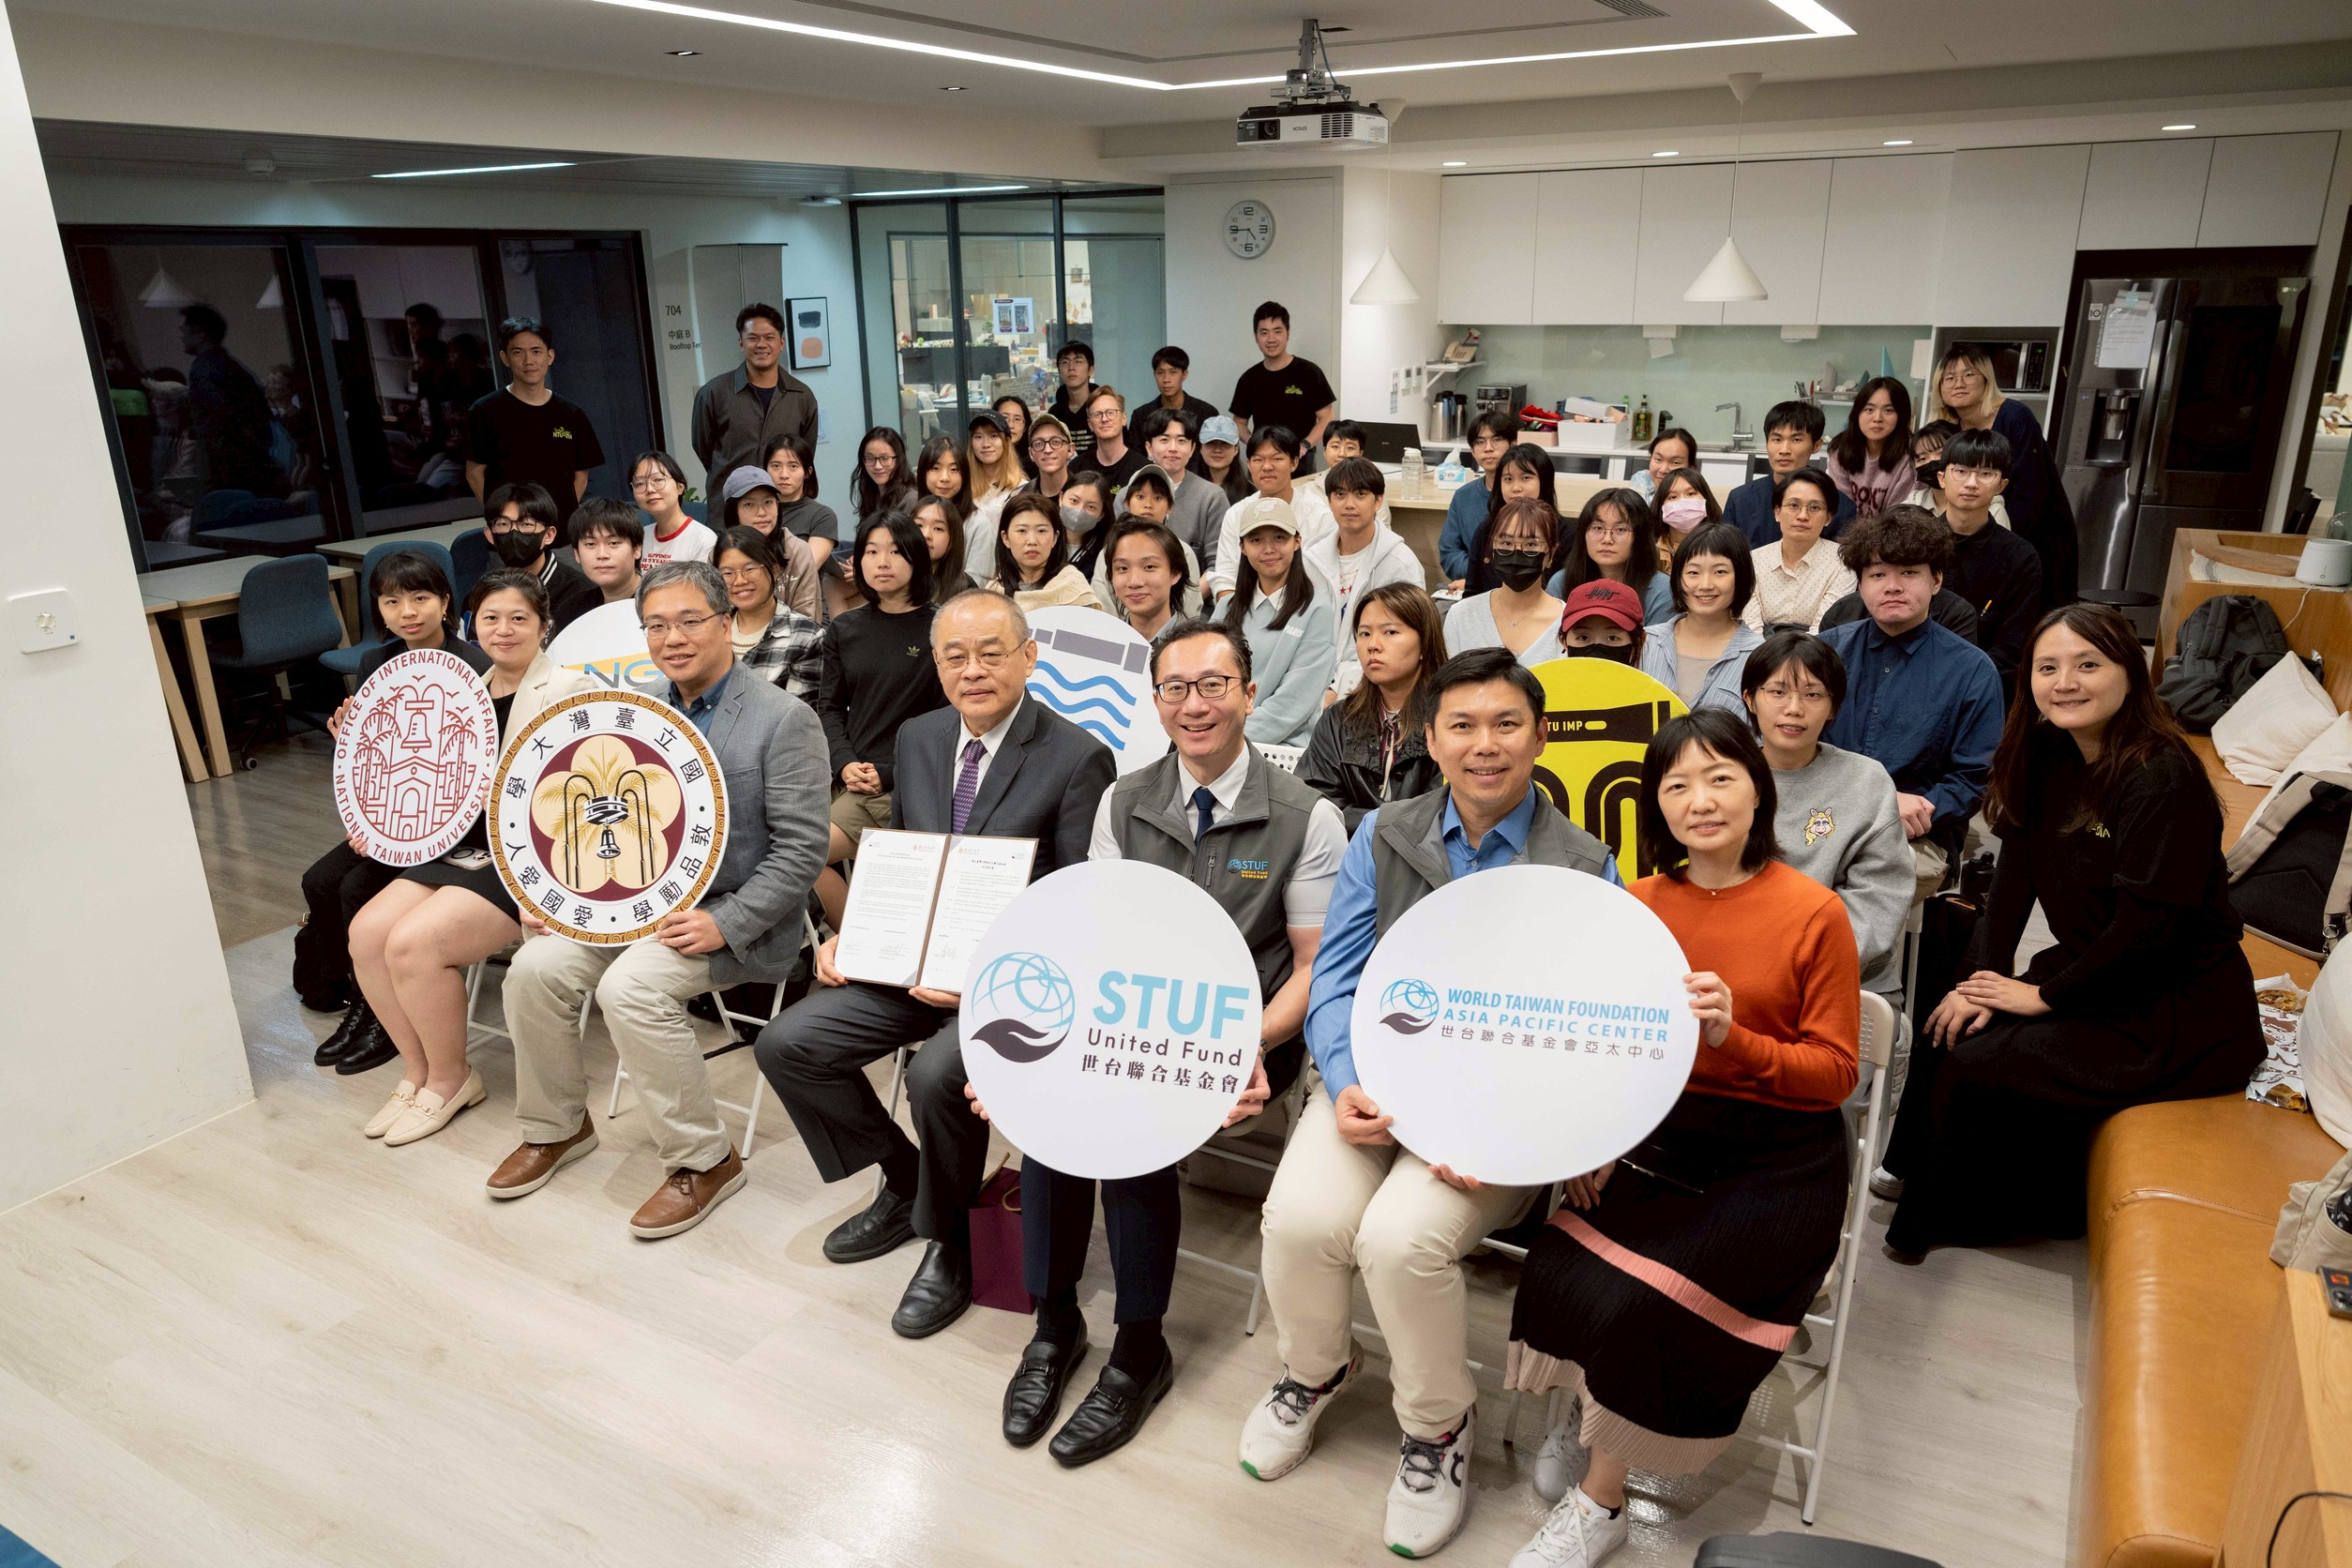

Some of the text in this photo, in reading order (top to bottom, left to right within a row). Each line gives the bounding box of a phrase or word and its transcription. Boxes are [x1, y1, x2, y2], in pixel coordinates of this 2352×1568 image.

[1244, 206, 1254, 216] 12
[1229, 225, 1239, 234] 9
[1259, 224, 1268, 234] 3
[1244, 243, 1254, 252] 6
[665, 305, 682, 316] 704
[668, 329, 691, 339] 中庭 B
[670, 342, 692, 351] Rooftop
[1284, 625, 1304, 638] PARIS
[336, 650, 496, 760] OFFICE OF INTERNATIONAL AFFAIRS
[1562, 720, 1583, 731] IMP
[372, 843, 423, 865] TAIWAN
[427, 772, 491, 859] UNIVERSITY
[1242, 860, 1269, 870] STUF
[1093, 970, 1250, 1040] STUF
[1447, 988, 1669, 1025] WORLD TAIWAN FOUNDATION
[1443, 1008, 1668, 1043] ASIA PACIFIC CENTER
[1087, 1027, 1243, 1067] United Fund
[1440, 1024, 1665, 1060] 世台聯合基金會亞太中心
[1081, 1053, 1240, 1094] 世台聯合基金會
